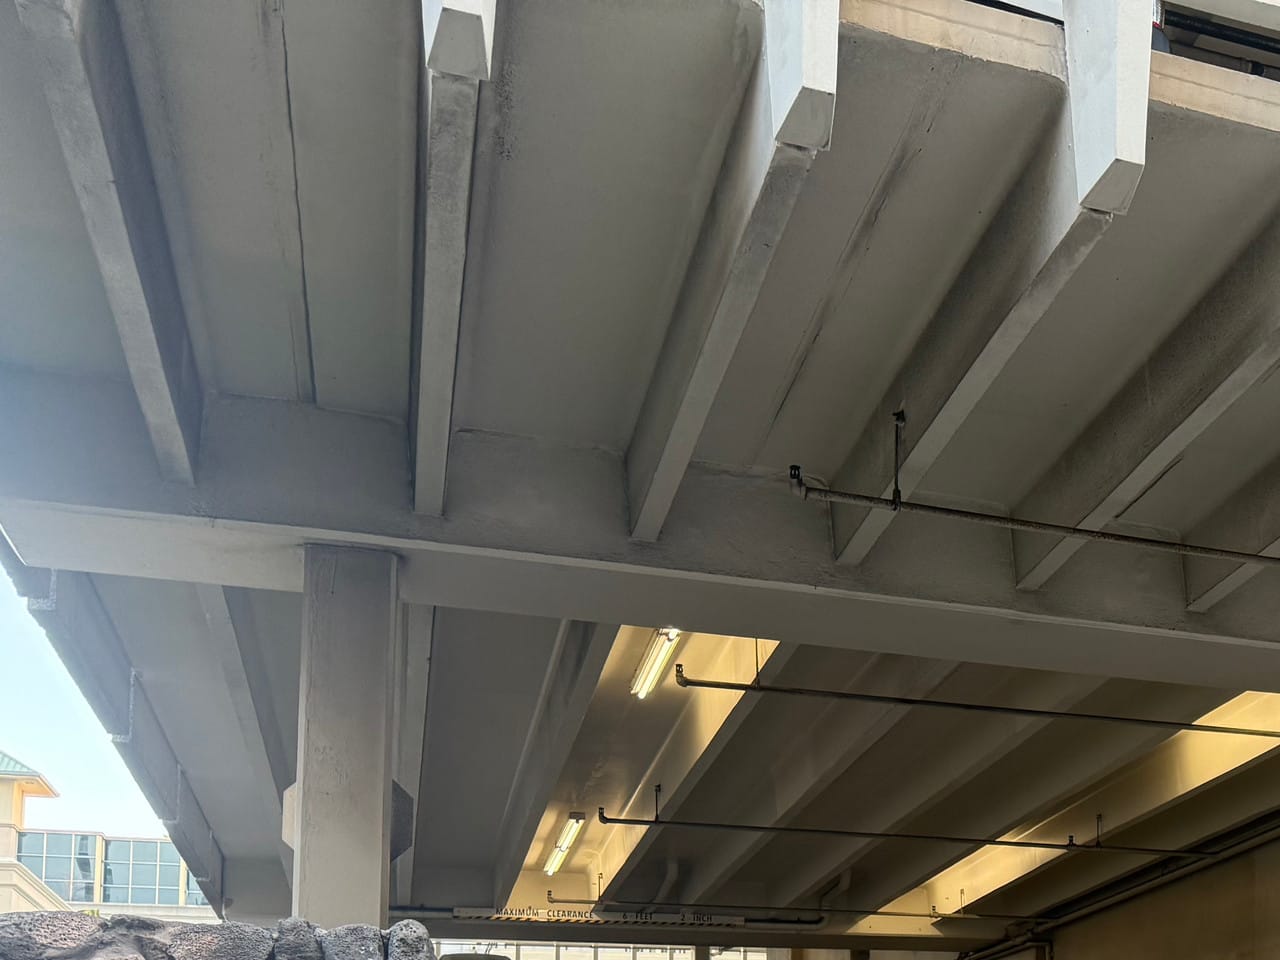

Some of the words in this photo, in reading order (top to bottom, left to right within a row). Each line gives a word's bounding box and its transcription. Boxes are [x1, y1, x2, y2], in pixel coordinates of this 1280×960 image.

[495, 907, 539, 917] MAXIMUM
[546, 909, 593, 919] CLEARANCE
[634, 912, 653, 920] FEET
[692, 913, 712, 922] INCH
